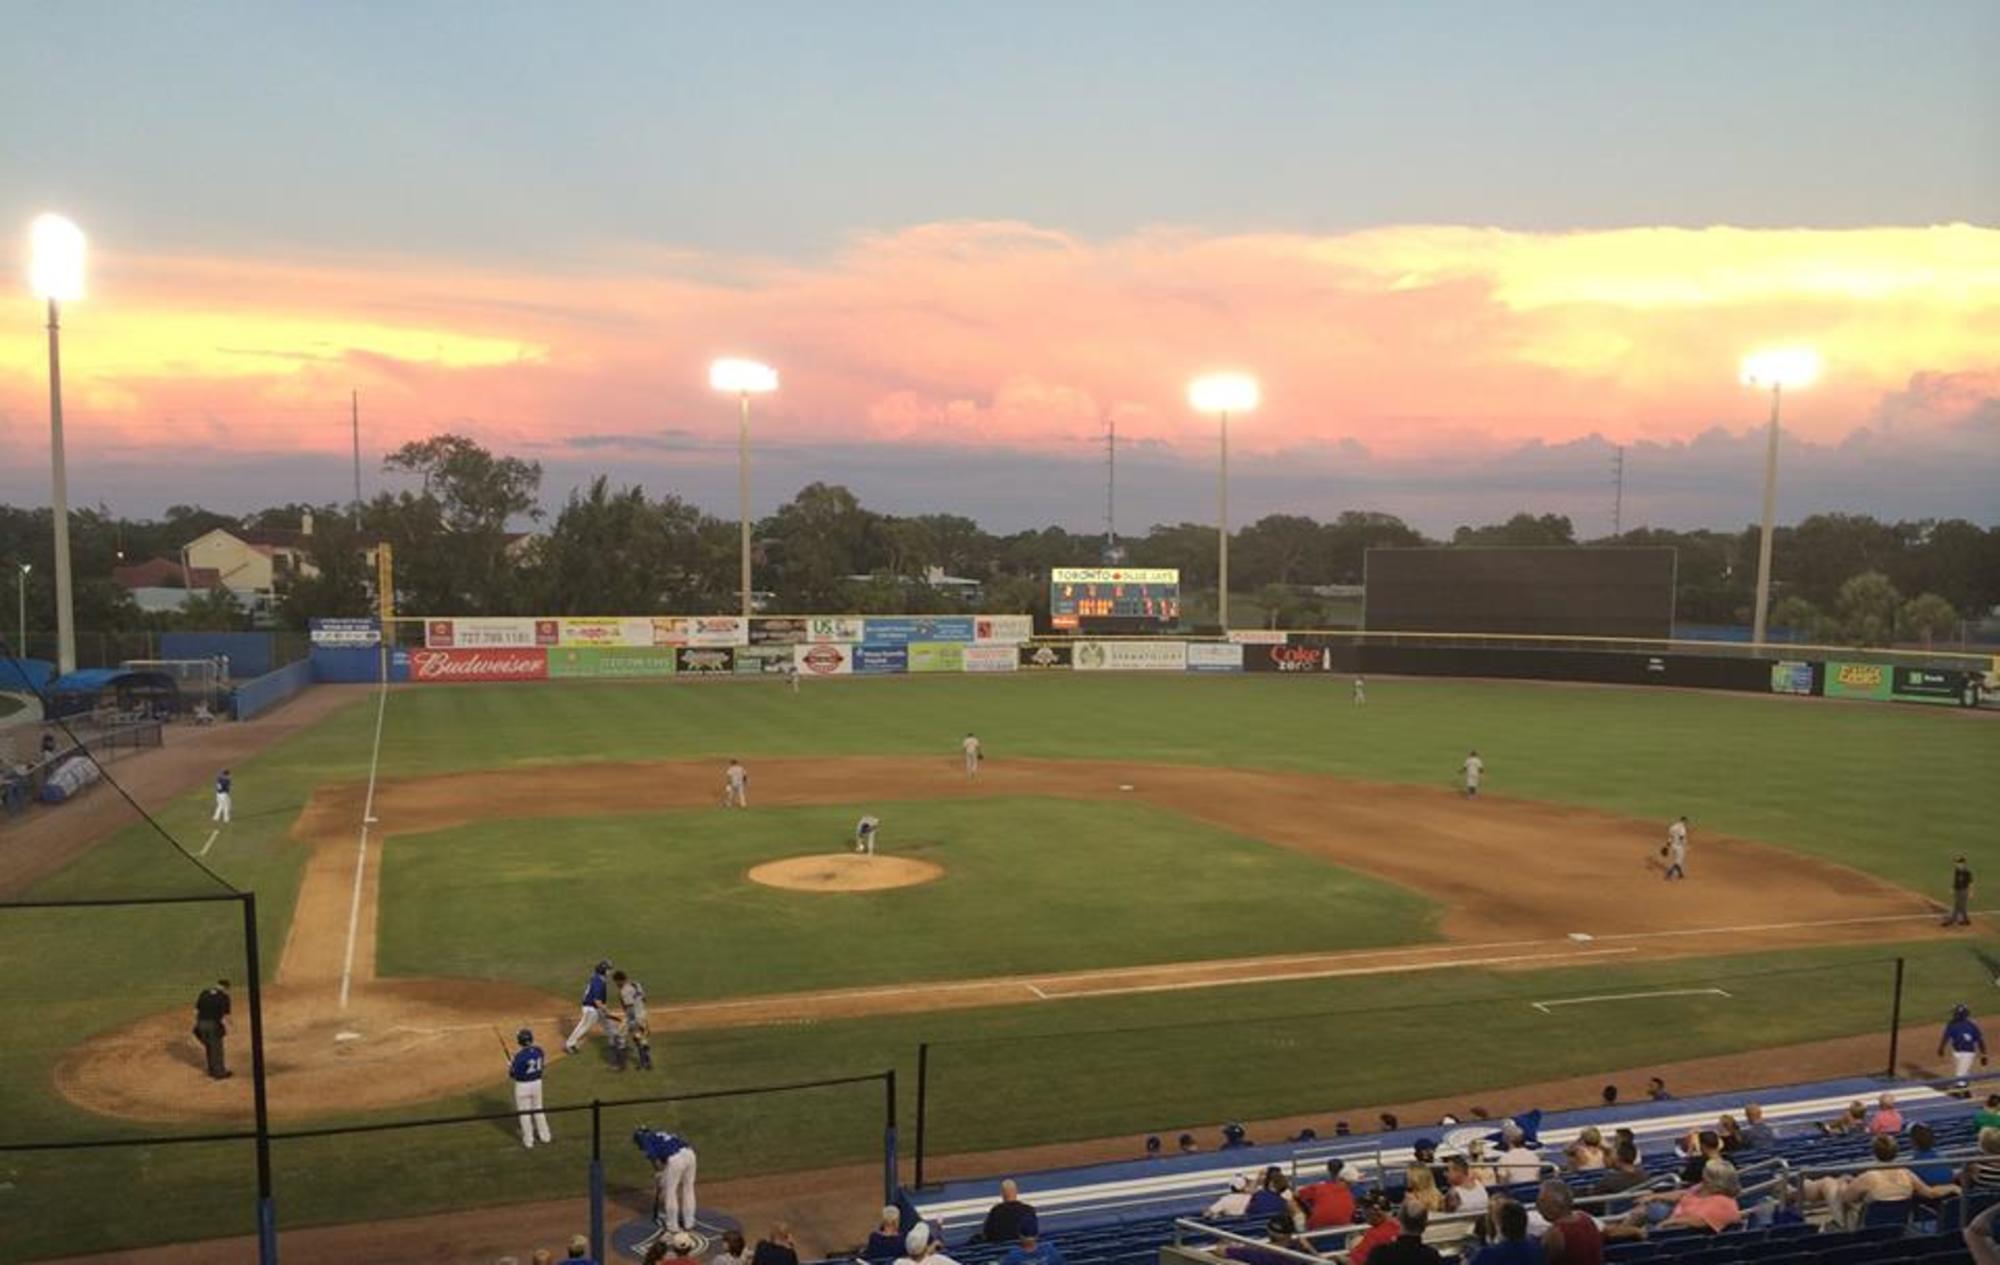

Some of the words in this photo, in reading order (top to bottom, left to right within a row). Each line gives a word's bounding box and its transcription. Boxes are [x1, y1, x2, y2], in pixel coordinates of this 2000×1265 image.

[1057, 570, 1110, 580] TORONTO
[1270, 645, 1321, 663] Coke
[413, 651, 544, 677] Budweiser
[1278, 660, 1313, 671] zero
